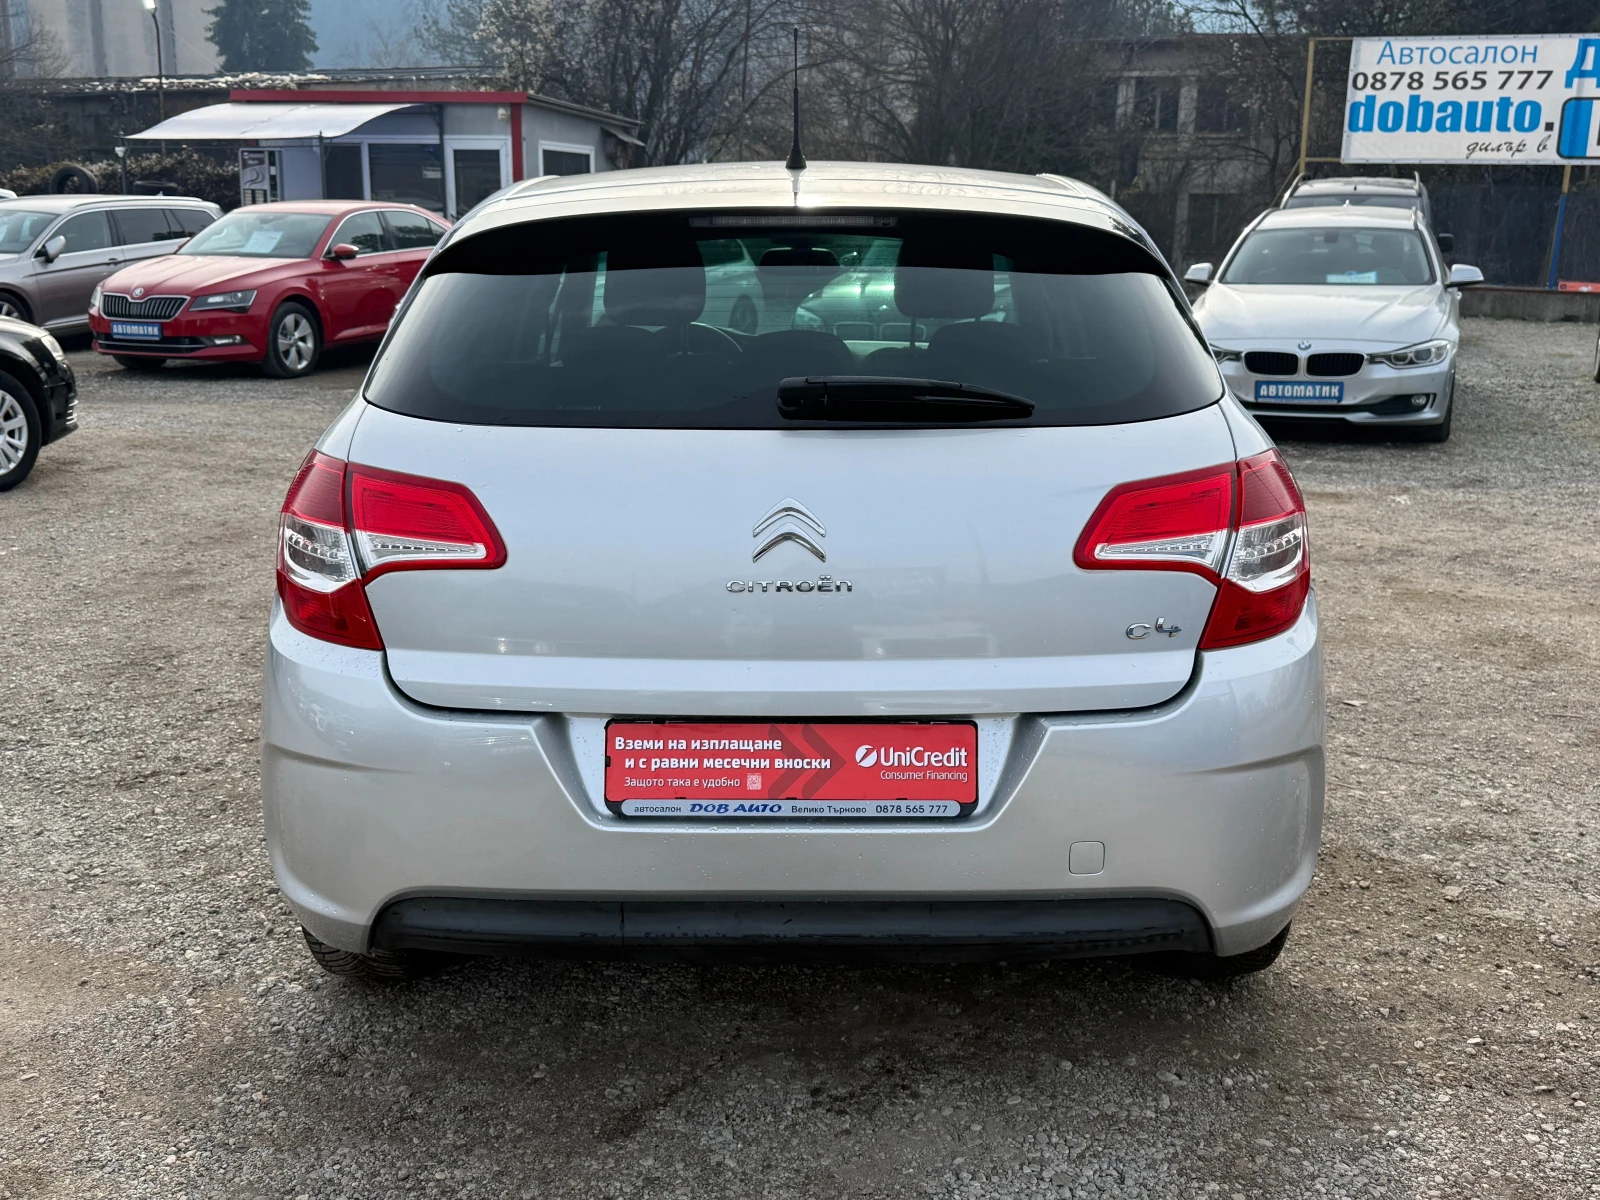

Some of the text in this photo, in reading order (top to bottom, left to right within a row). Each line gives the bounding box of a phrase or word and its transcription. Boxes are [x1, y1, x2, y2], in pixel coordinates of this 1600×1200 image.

[1377, 40, 1538, 65] Автосалон
[1352, 70, 1554, 91] 0878 565 777
[1466, 138, 1527, 159] дилър
[112, 324, 159, 336] АВТОМАТИК
[1259, 384, 1340, 397] АВТОМАТИК
[615, 737, 782, 752] Вземи на изплащане
[880, 746, 968, 767] UniCredit
[625, 758, 831, 771] и с равни месечни вноски
[880, 770, 968, 782] Consumer Financing
[624, 777, 741, 789] Защото така е удобно
[634, 803, 948, 815] автосалон DOB AUTO Велико Търново 0878 565 777
